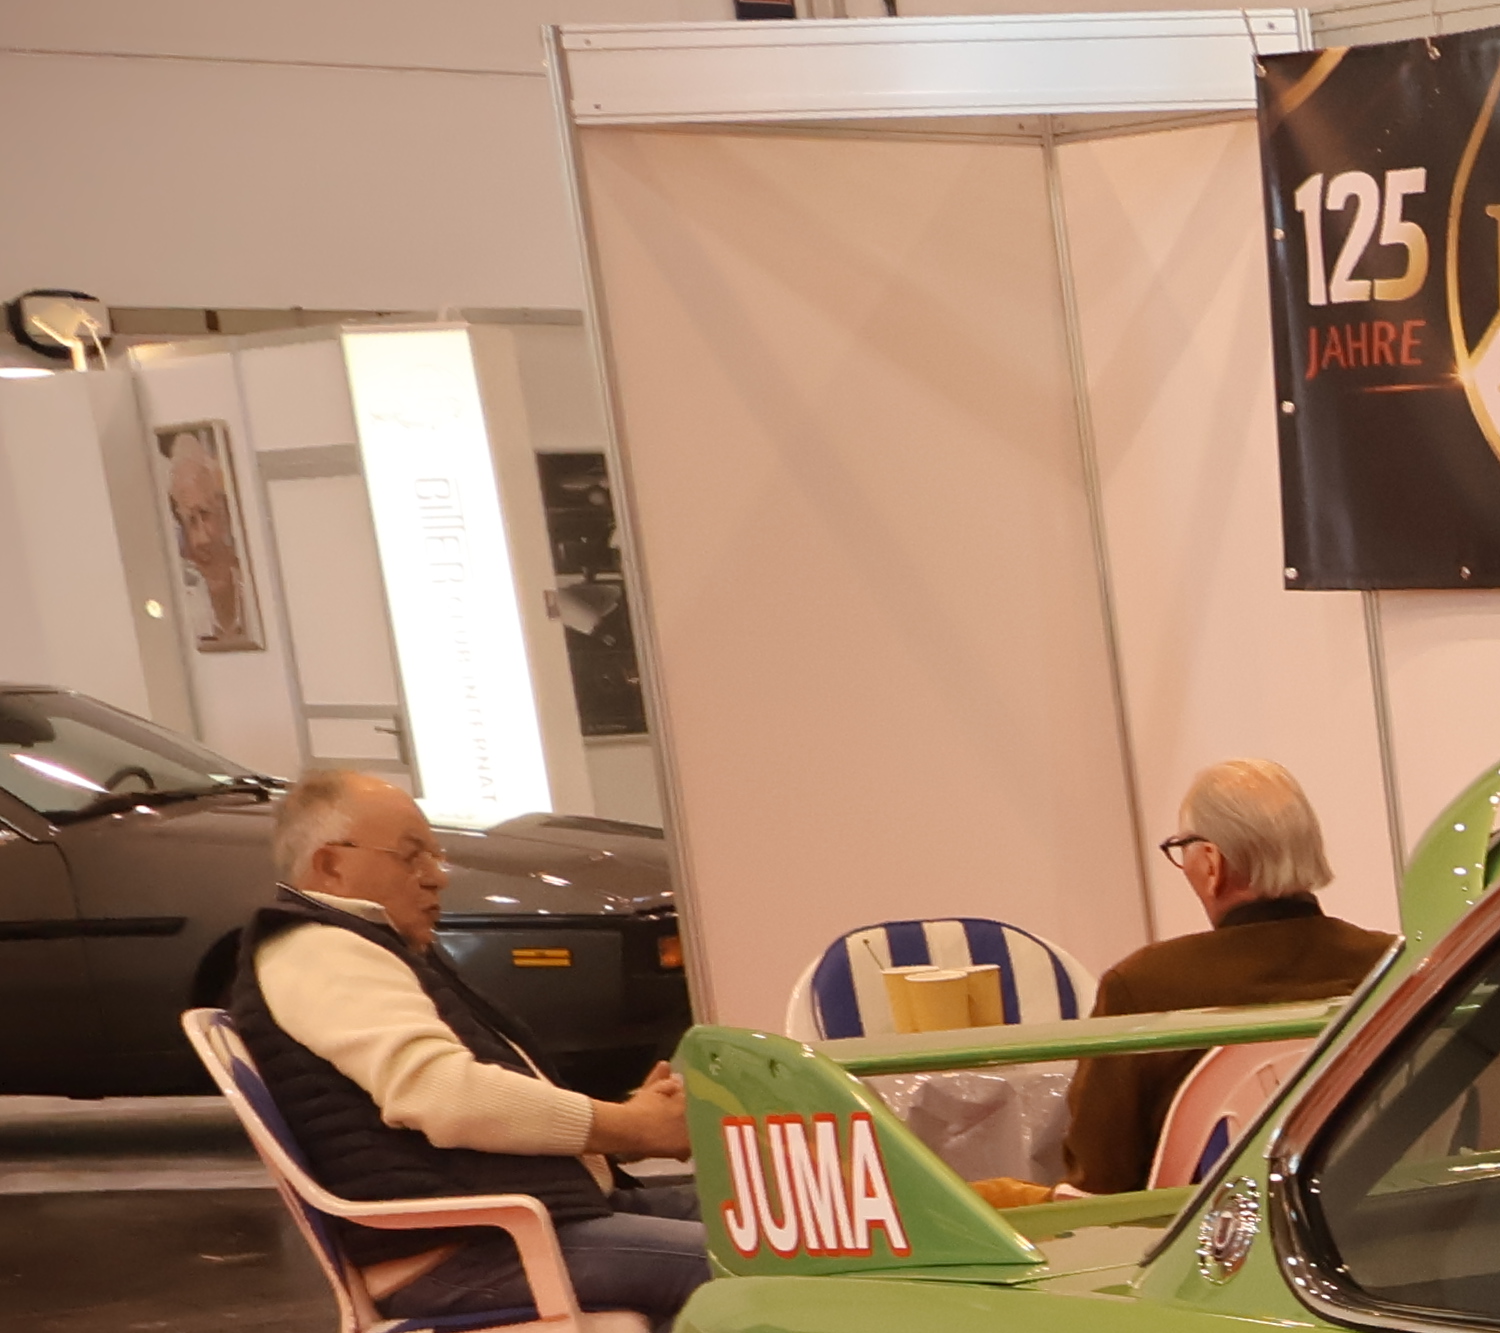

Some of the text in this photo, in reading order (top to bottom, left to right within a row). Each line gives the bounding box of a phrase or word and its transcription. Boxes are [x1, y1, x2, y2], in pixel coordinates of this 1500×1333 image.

[1294, 167, 1430, 307] 125
[1305, 320, 1428, 380] JAHRE
[721, 1111, 911, 1259] JUMA
